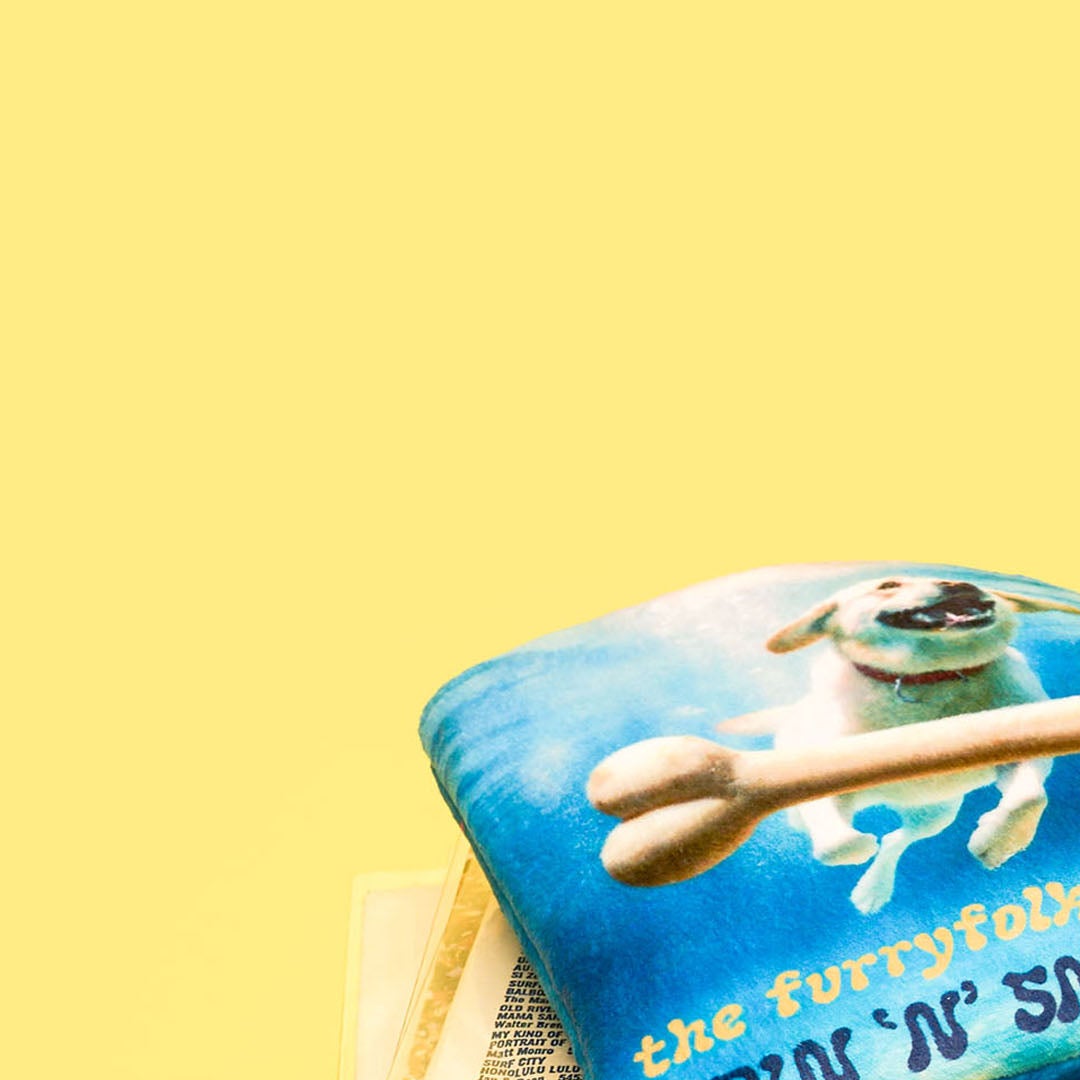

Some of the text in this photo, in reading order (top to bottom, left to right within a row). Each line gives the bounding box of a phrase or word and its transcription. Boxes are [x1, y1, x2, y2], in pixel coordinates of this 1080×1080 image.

[505, 988, 547, 996] BALBO
[494, 1021, 534, 1029] Walter
[491, 1030, 564, 1040] MY KIND OF
[633, 1003, 747, 1078] the
[489, 1038, 568, 1050] PORTRAIT OF
[486, 1047, 555, 1058] Matt Monro
[483, 1056, 547, 1069] SURF CITY
[480, 1065, 581, 1078] HONOLULU LULU
